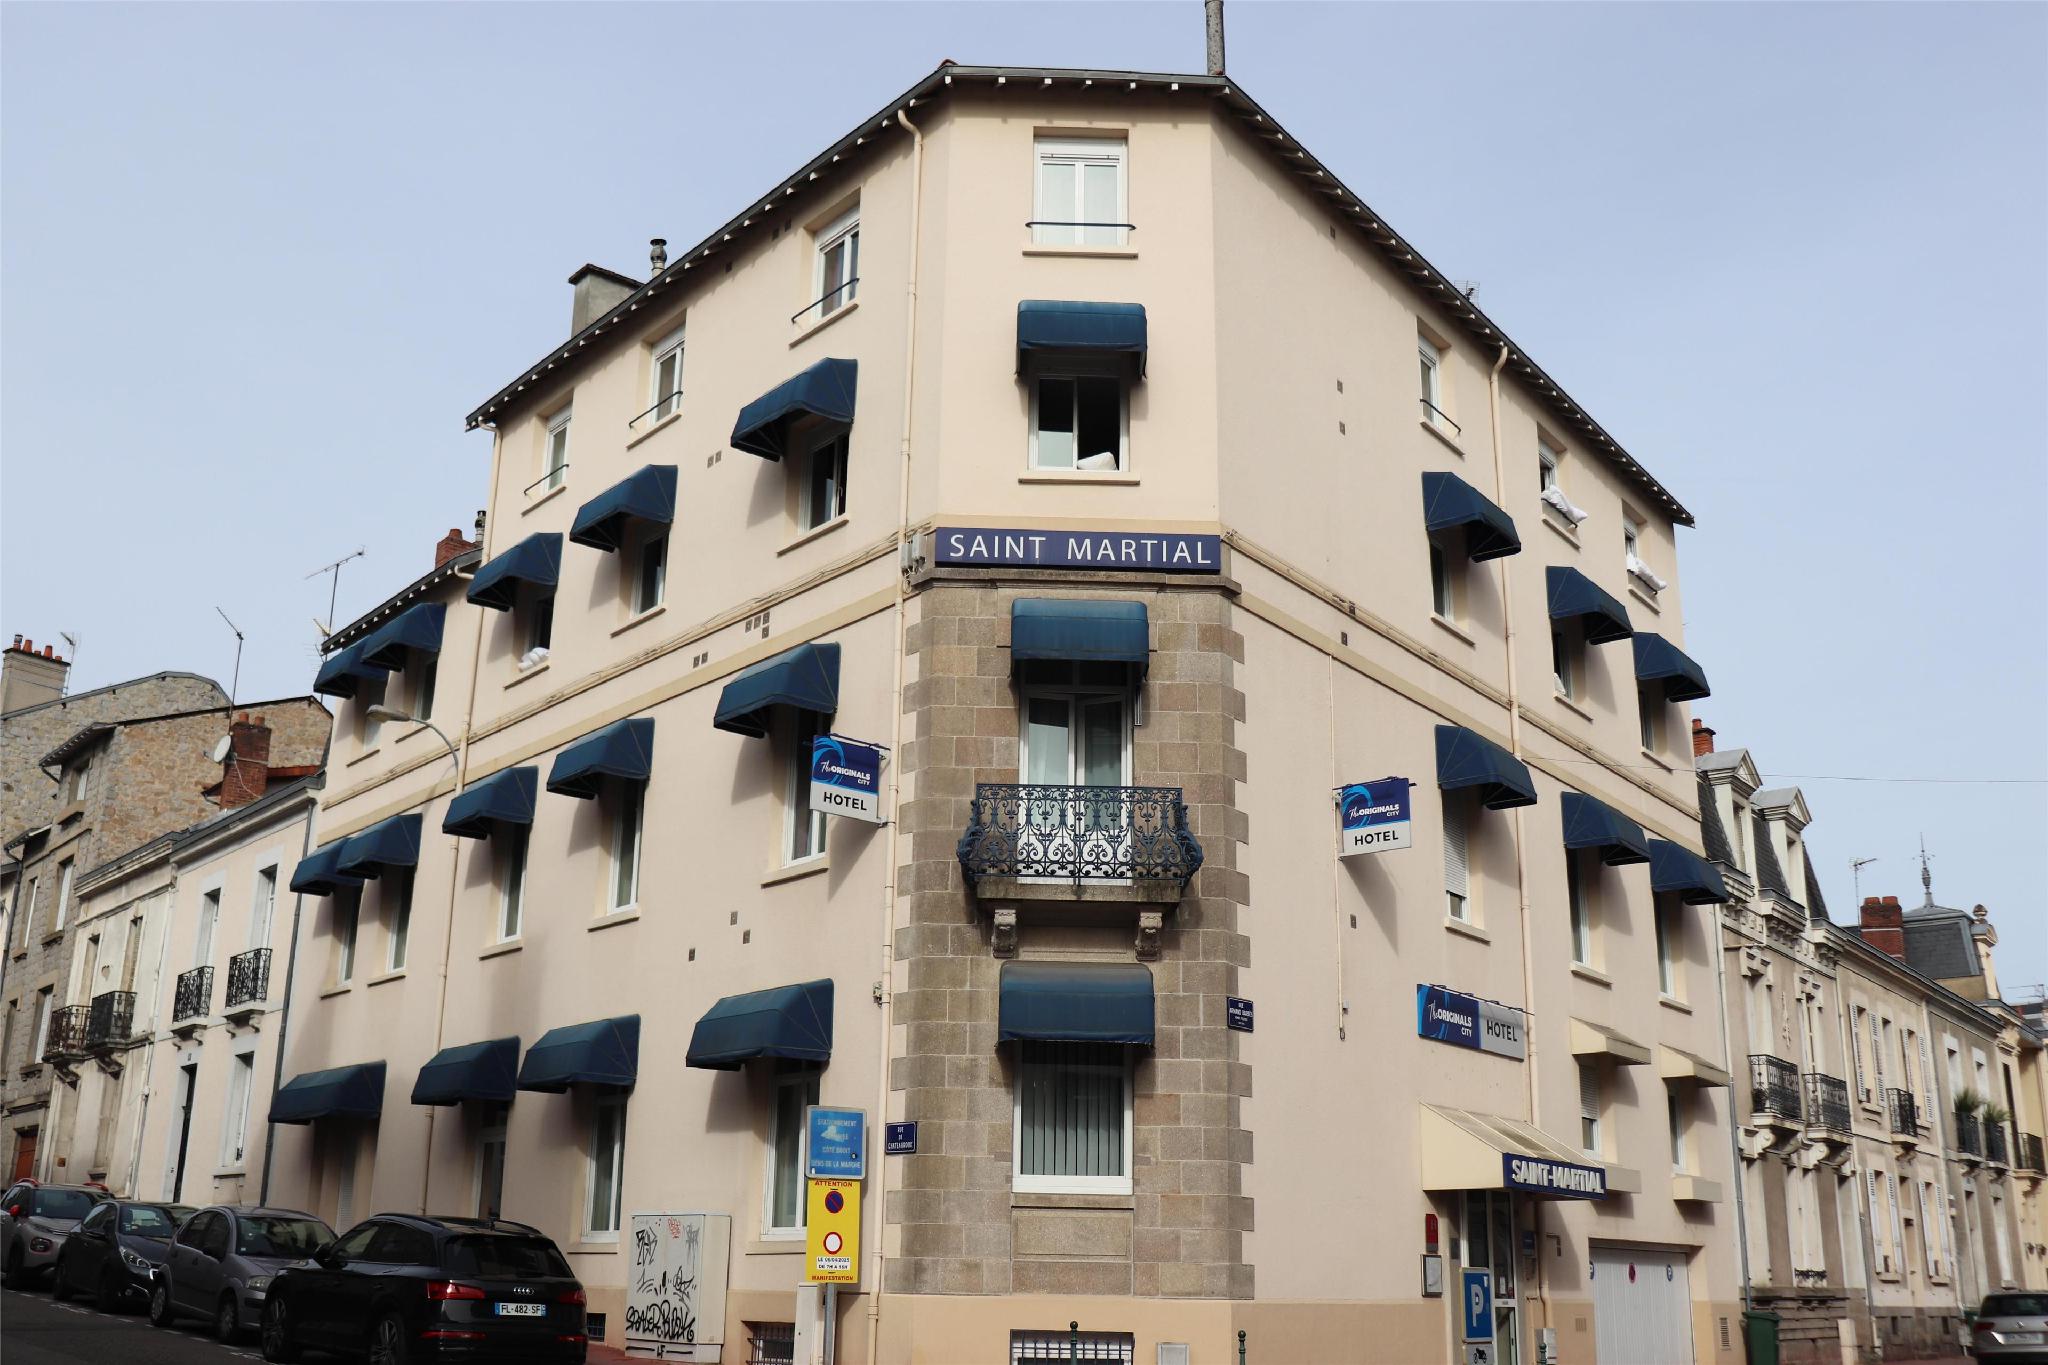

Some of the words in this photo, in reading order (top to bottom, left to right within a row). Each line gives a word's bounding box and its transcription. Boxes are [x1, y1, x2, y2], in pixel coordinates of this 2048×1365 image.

[949, 533, 1046, 559] SAINT
[1066, 538, 1212, 564] MARTIAL
[831, 765, 871, 780] ORIGINALS
[857, 778, 870, 786] CITY
[823, 791, 868, 811] HOTEL
[1358, 803, 1400, 816] ORIGINALS
[1354, 830, 1399, 846] HOTEL
[1437, 1008, 1472, 1027] ORIGINALS
[1461, 1026, 1472, 1037] CITY
[1486, 1019, 1518, 1042] HOTEL
[1511, 1159, 1605, 1194] SAINT-MARTIAL
[501, 1304, 541, 1314] FL-482-SF
[1470, 1284, 1484, 1327] P
